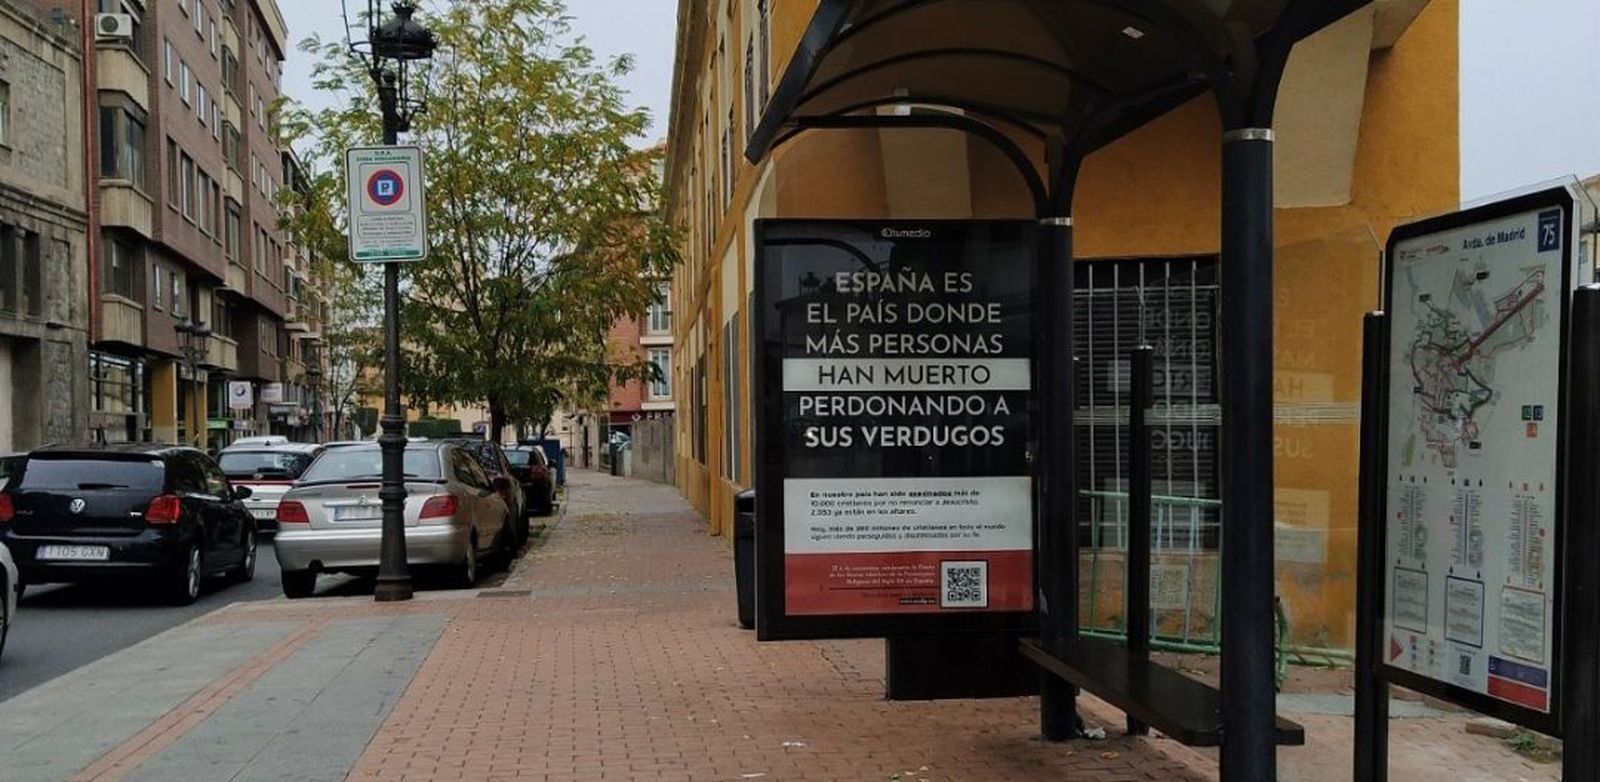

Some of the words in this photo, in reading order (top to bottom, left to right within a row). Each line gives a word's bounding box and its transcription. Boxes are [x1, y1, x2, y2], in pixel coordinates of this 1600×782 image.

[1462, 239, 1485, 250] Avda.
[1485, 234, 1496, 246] de
[1497, 226, 1526, 244] Madrid
[1542, 223, 1556, 247] 75
[836, 267, 935, 293] ESPAÑA
[944, 272, 973, 293] ES
[807, 303, 837, 324] EL
[847, 299, 899, 324] PAÍS
[907, 303, 1002, 324] DONDE
[806, 329, 860, 354] MÁS
[869, 334, 1003, 354] PERSONAS
[818, 365, 874, 385] HAN
[885, 365, 991, 385] MUERTO
[800, 396, 986, 417] PERDONANDO
[993, 396, 1011, 416] A
[805, 427, 853, 448] SUS
[862, 426, 1005, 448] VERDUGOS
[855, 491, 872, 499] país
[874, 500, 886, 508] por
